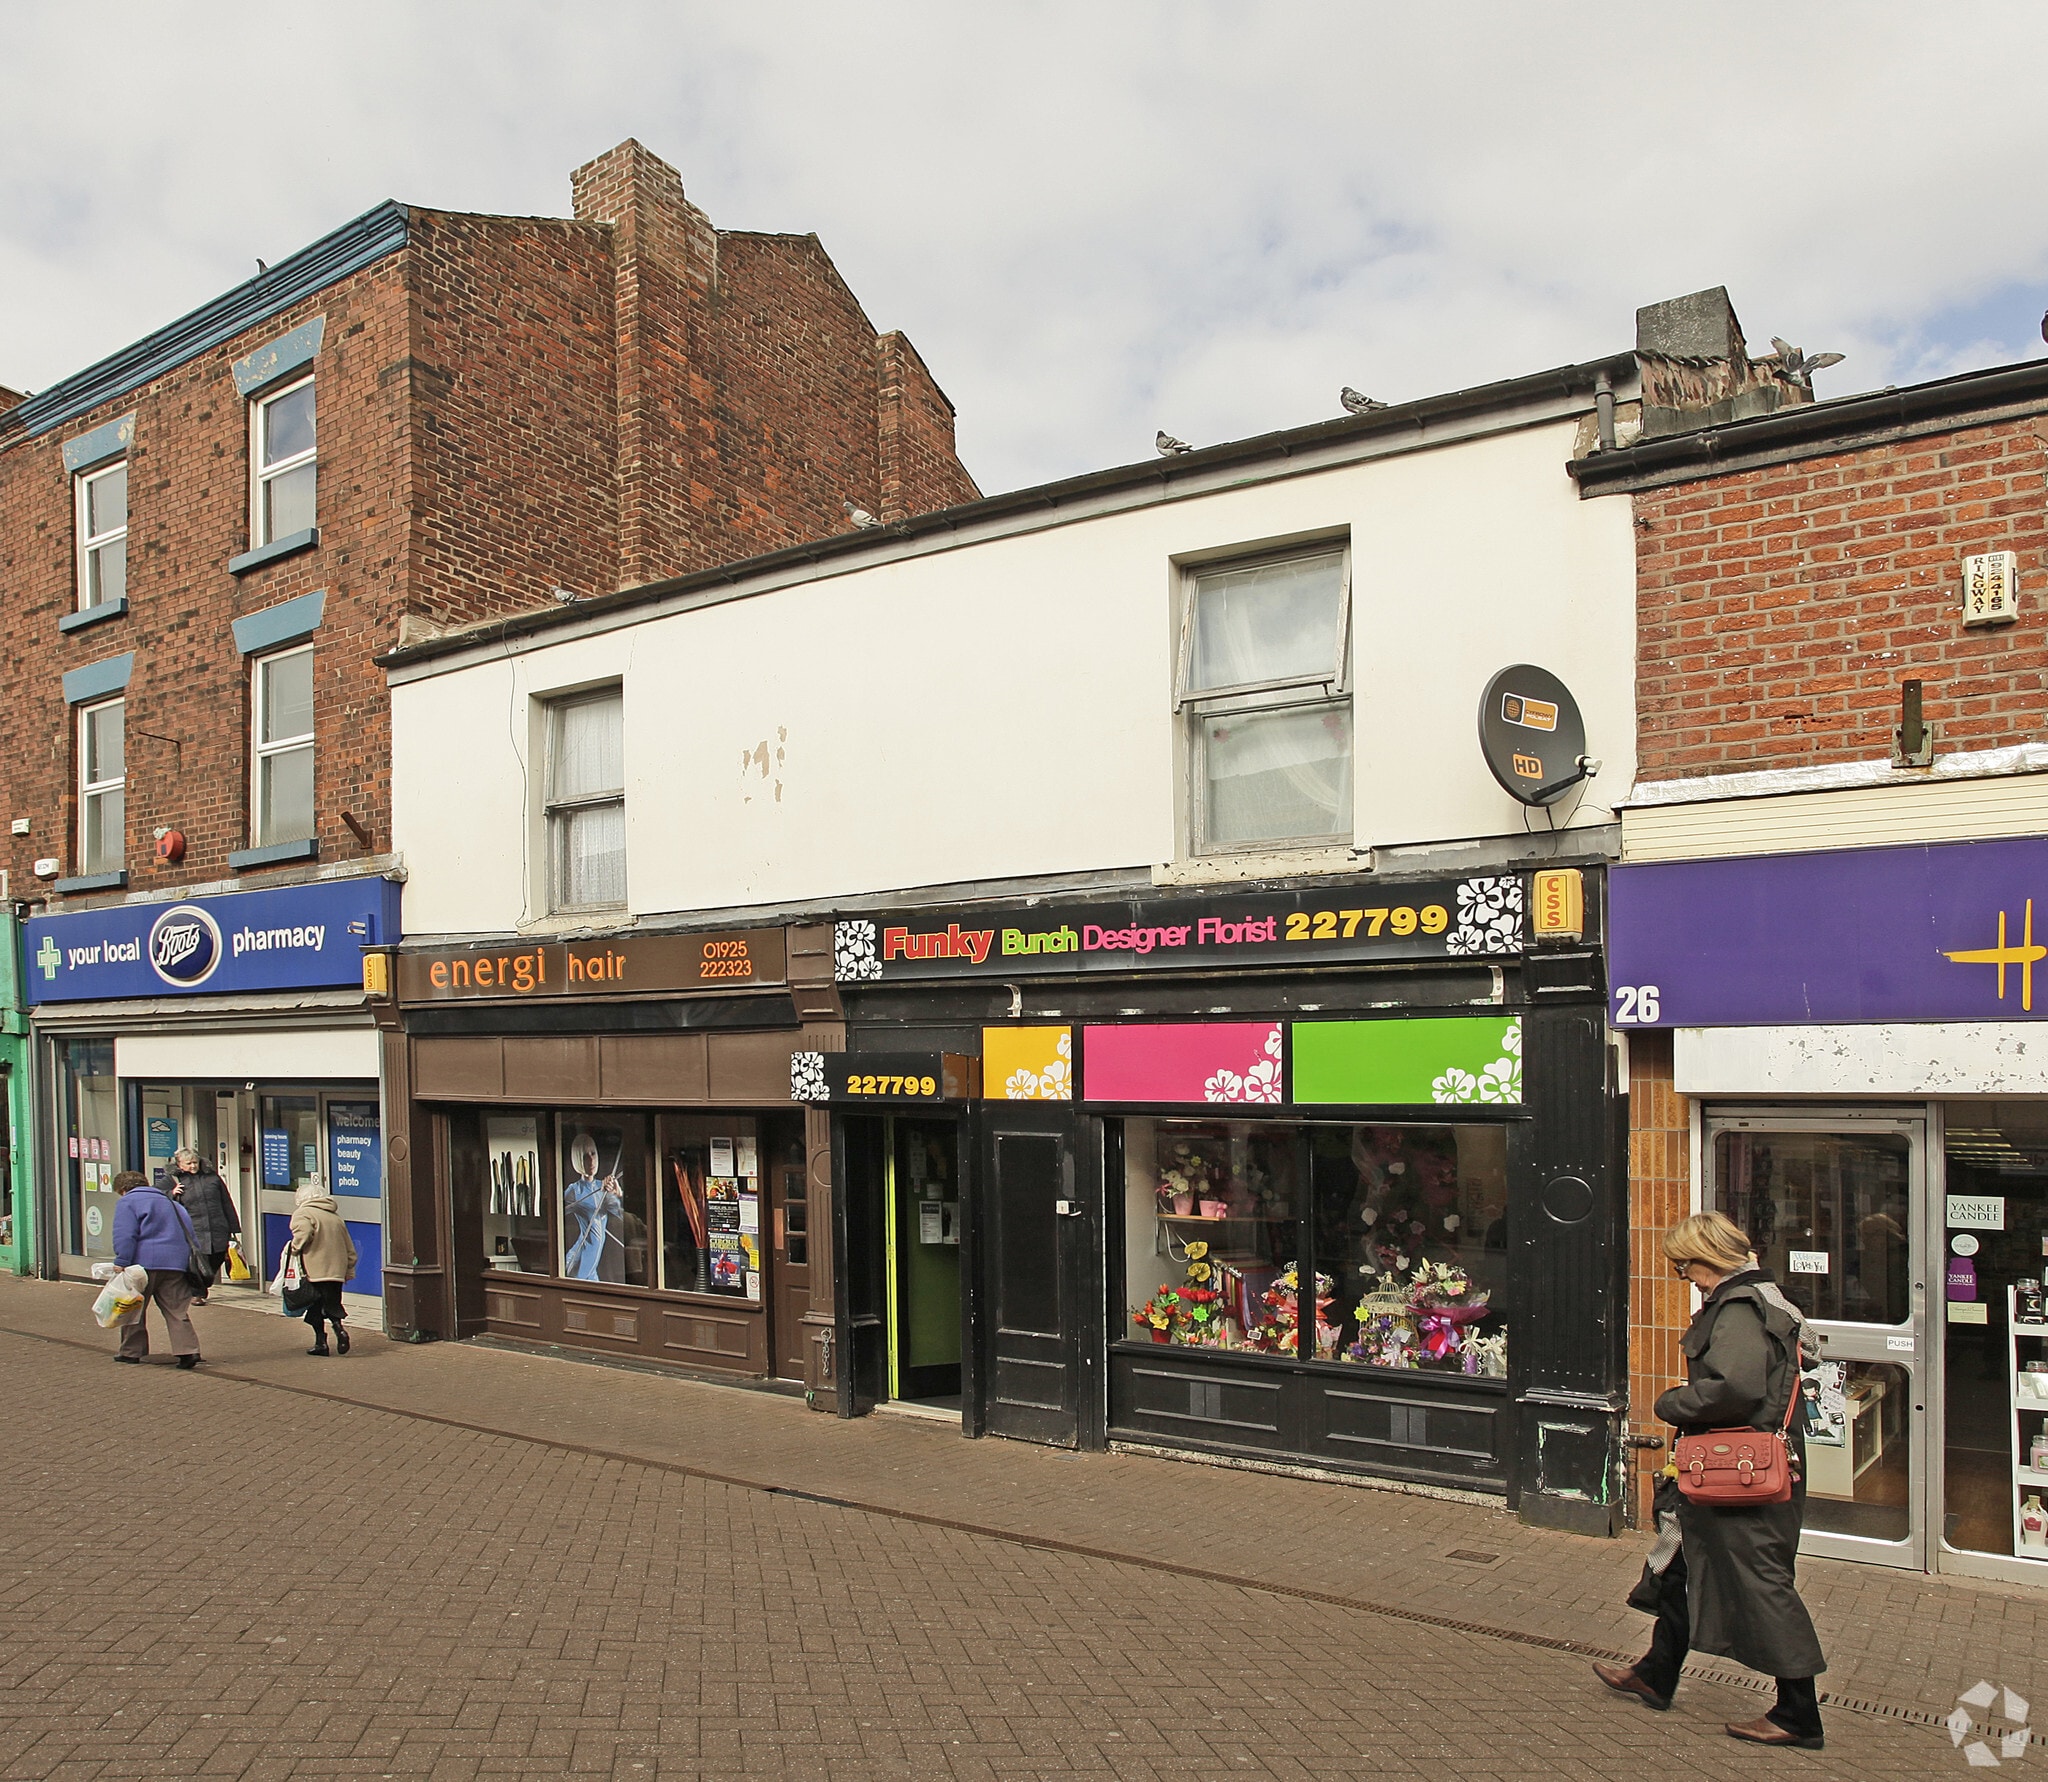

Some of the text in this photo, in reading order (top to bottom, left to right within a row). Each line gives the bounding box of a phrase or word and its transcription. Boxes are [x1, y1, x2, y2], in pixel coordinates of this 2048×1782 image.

[1971, 557, 1987, 613] RINGWAY
[1515, 758, 1540, 774] HD
[1547, 877, 1561, 927] CSS
[232, 925, 326, 958] pharmacy
[883, 904, 1448, 964] Funky Bunch Designer Florist 227799
[68, 936, 141, 971] your local
[156, 923, 201, 967] Boots
[703, 940, 749, 959] 01925
[429, 947, 627, 993] energi hair
[700, 959, 752, 978] 222323
[1615, 985, 1660, 1024] 26
[847, 1075, 936, 1096] 227799
[335, 1113, 380, 1129] welcome
[337, 1135, 372, 1147] pharmacy
[337, 1149, 361, 1161] beauty
[337, 1162, 356, 1174] baby
[338, 1176, 360, 1187] photo
[1950, 1211, 1999, 1222] CANDLE
[1951, 1202, 1999, 1213] YANKEE
[1888, 1339, 1913, 1348] PUSH
